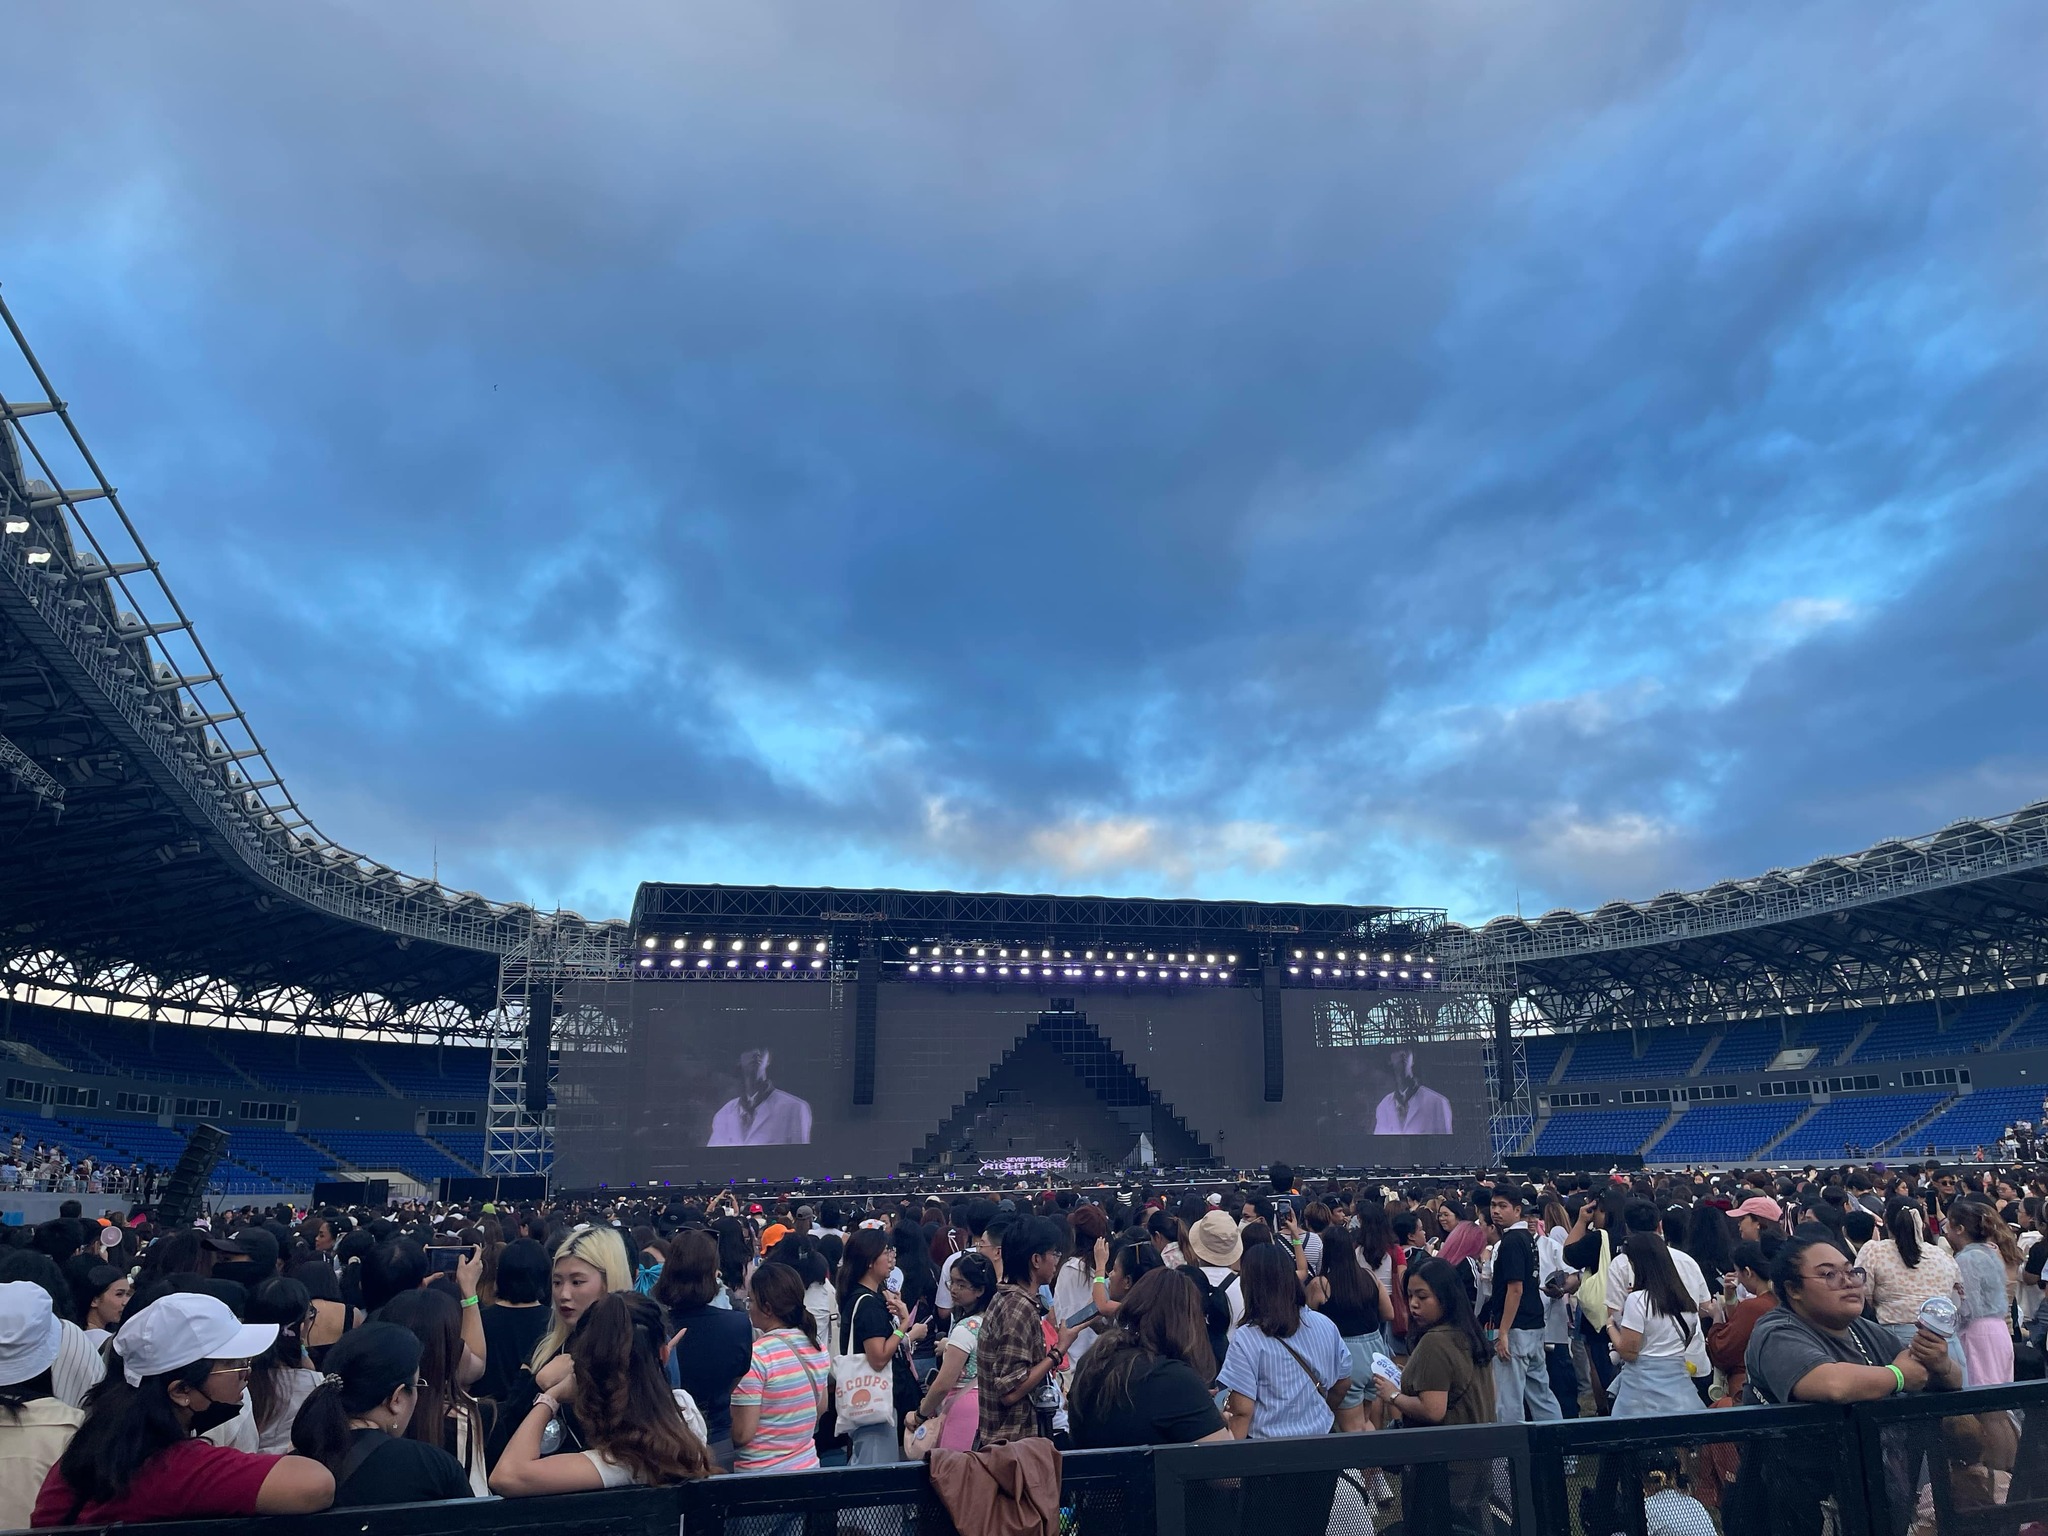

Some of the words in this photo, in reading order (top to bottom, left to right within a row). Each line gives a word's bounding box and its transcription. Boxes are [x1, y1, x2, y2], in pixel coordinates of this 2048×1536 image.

[984, 1162, 1026, 1170] RIGHT
[1030, 1161, 1067, 1169] HERE
[836, 1375, 889, 1398] S.COUPS
